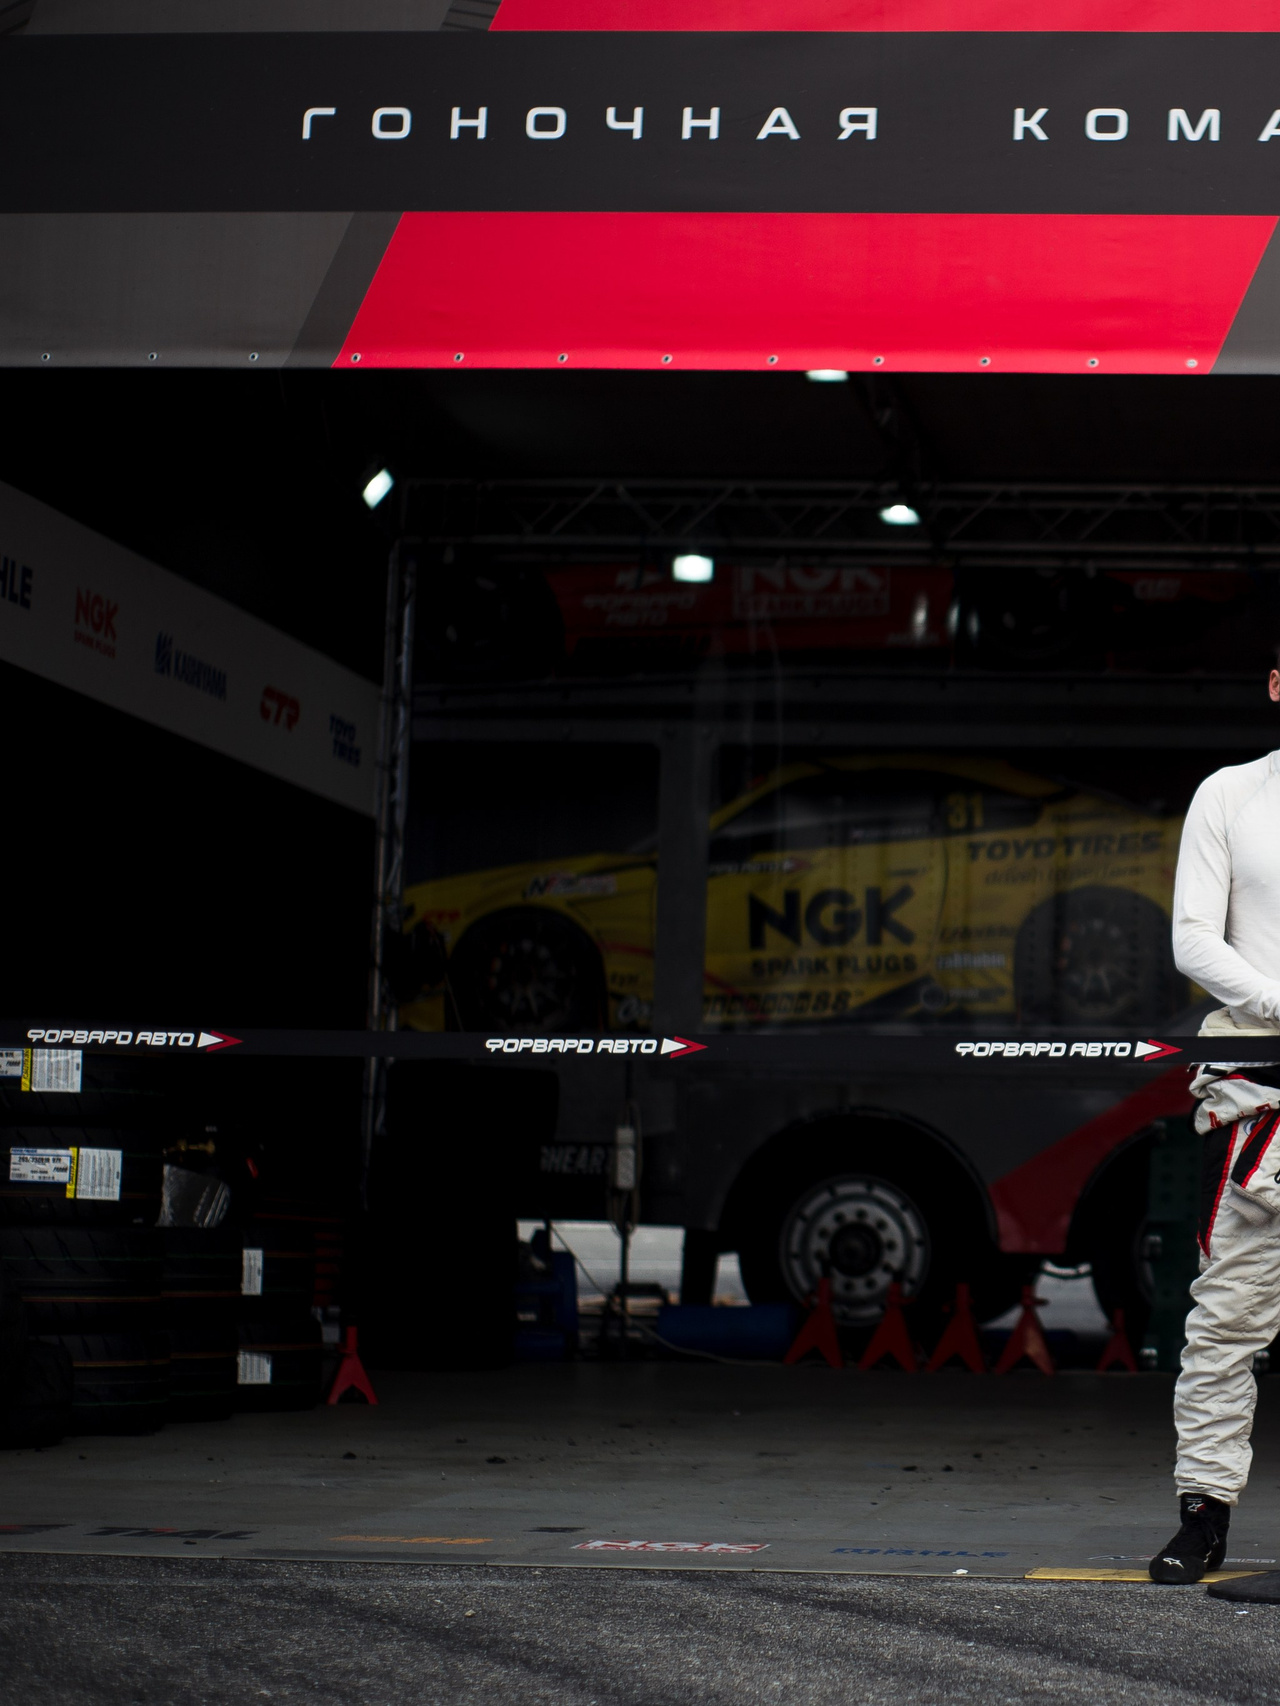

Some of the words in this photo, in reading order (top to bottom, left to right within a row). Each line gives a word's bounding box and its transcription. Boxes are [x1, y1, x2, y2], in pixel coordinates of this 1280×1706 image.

[302, 106, 878, 140] ГОНОЧНАЯ
[74, 586, 119, 641] NGK
[967, 838, 1058, 861] TOYO
[1062, 830, 1165, 856] TIRES
[749, 885, 916, 949] NGK
[752, 957, 829, 978] SPARK
[837, 954, 917, 975] PLUGS
